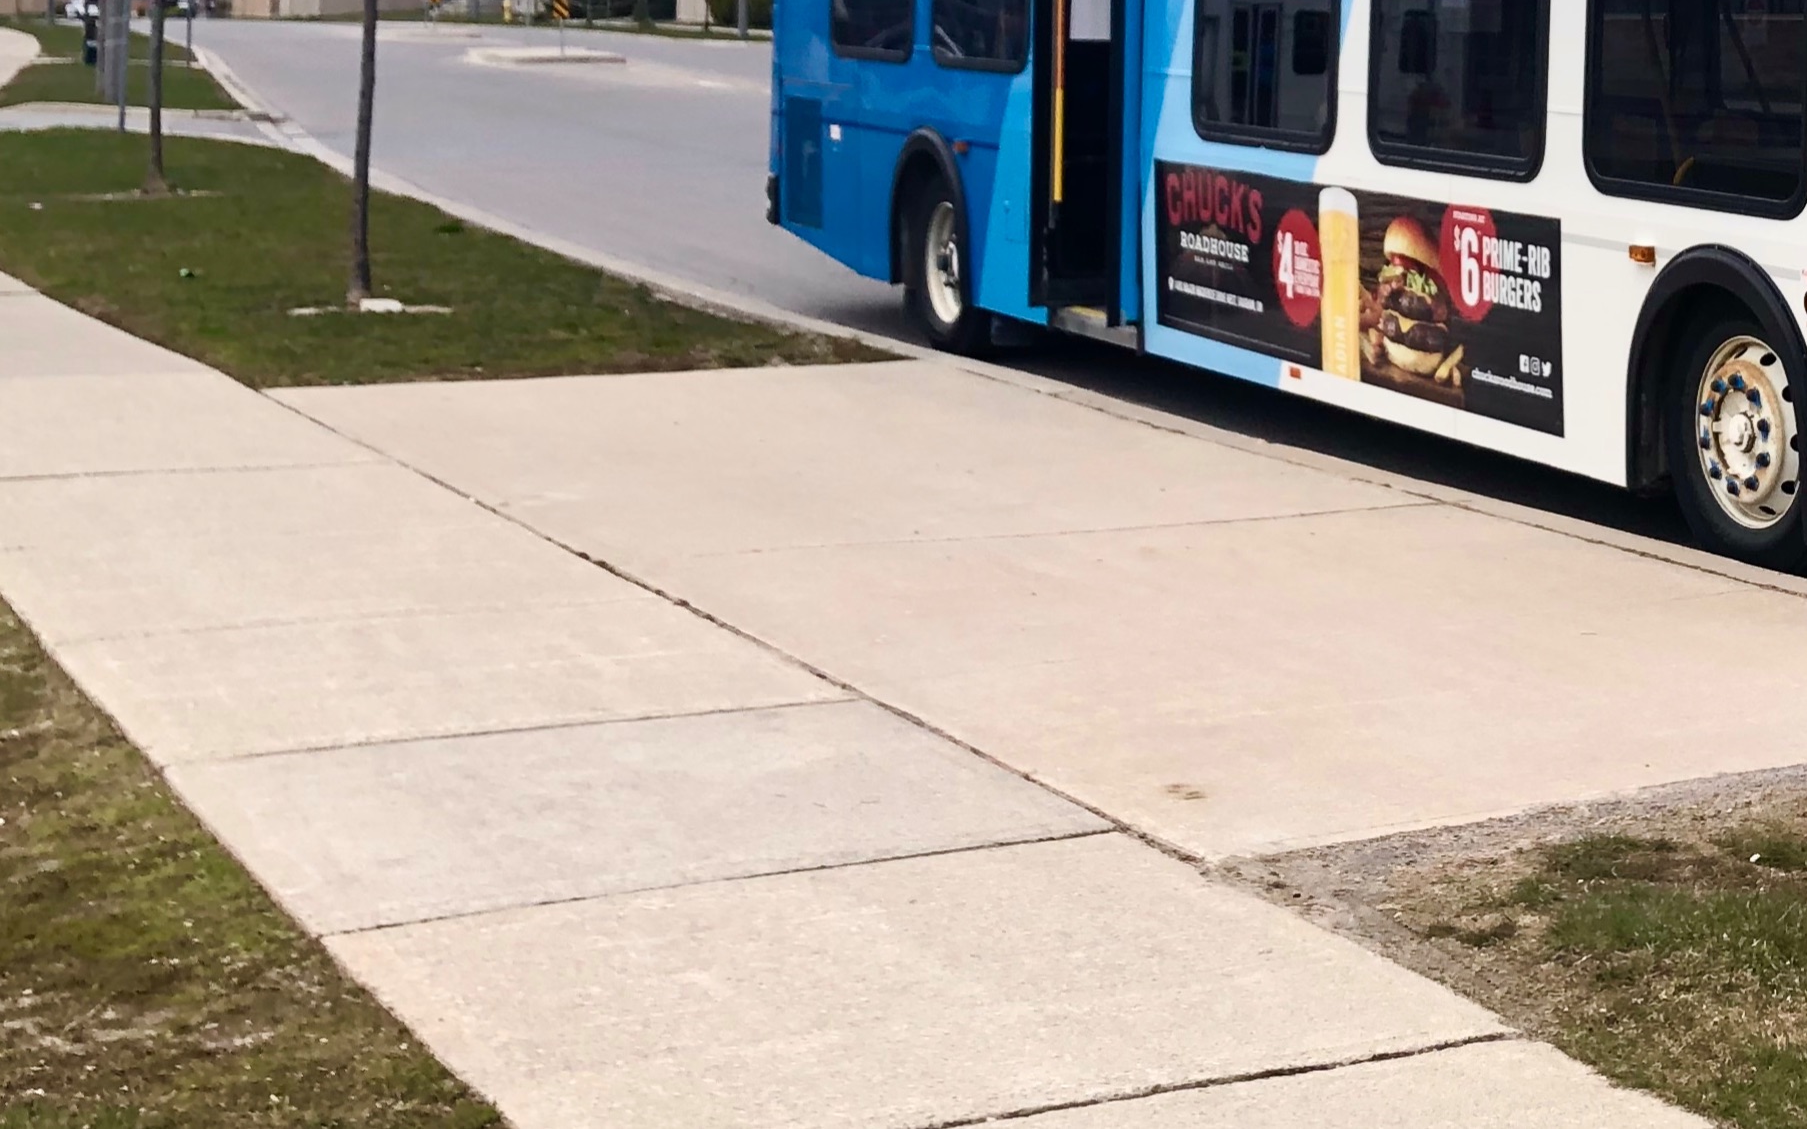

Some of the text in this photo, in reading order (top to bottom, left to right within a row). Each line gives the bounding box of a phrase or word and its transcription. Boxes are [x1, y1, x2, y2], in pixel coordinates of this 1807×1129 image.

[1166, 170, 1264, 244] CHUCK'S
[1180, 230, 1250, 263] ROADHOUSE
[1482, 235, 1551, 279] PRIME-RIB
[1482, 270, 1542, 313] BURGERS
